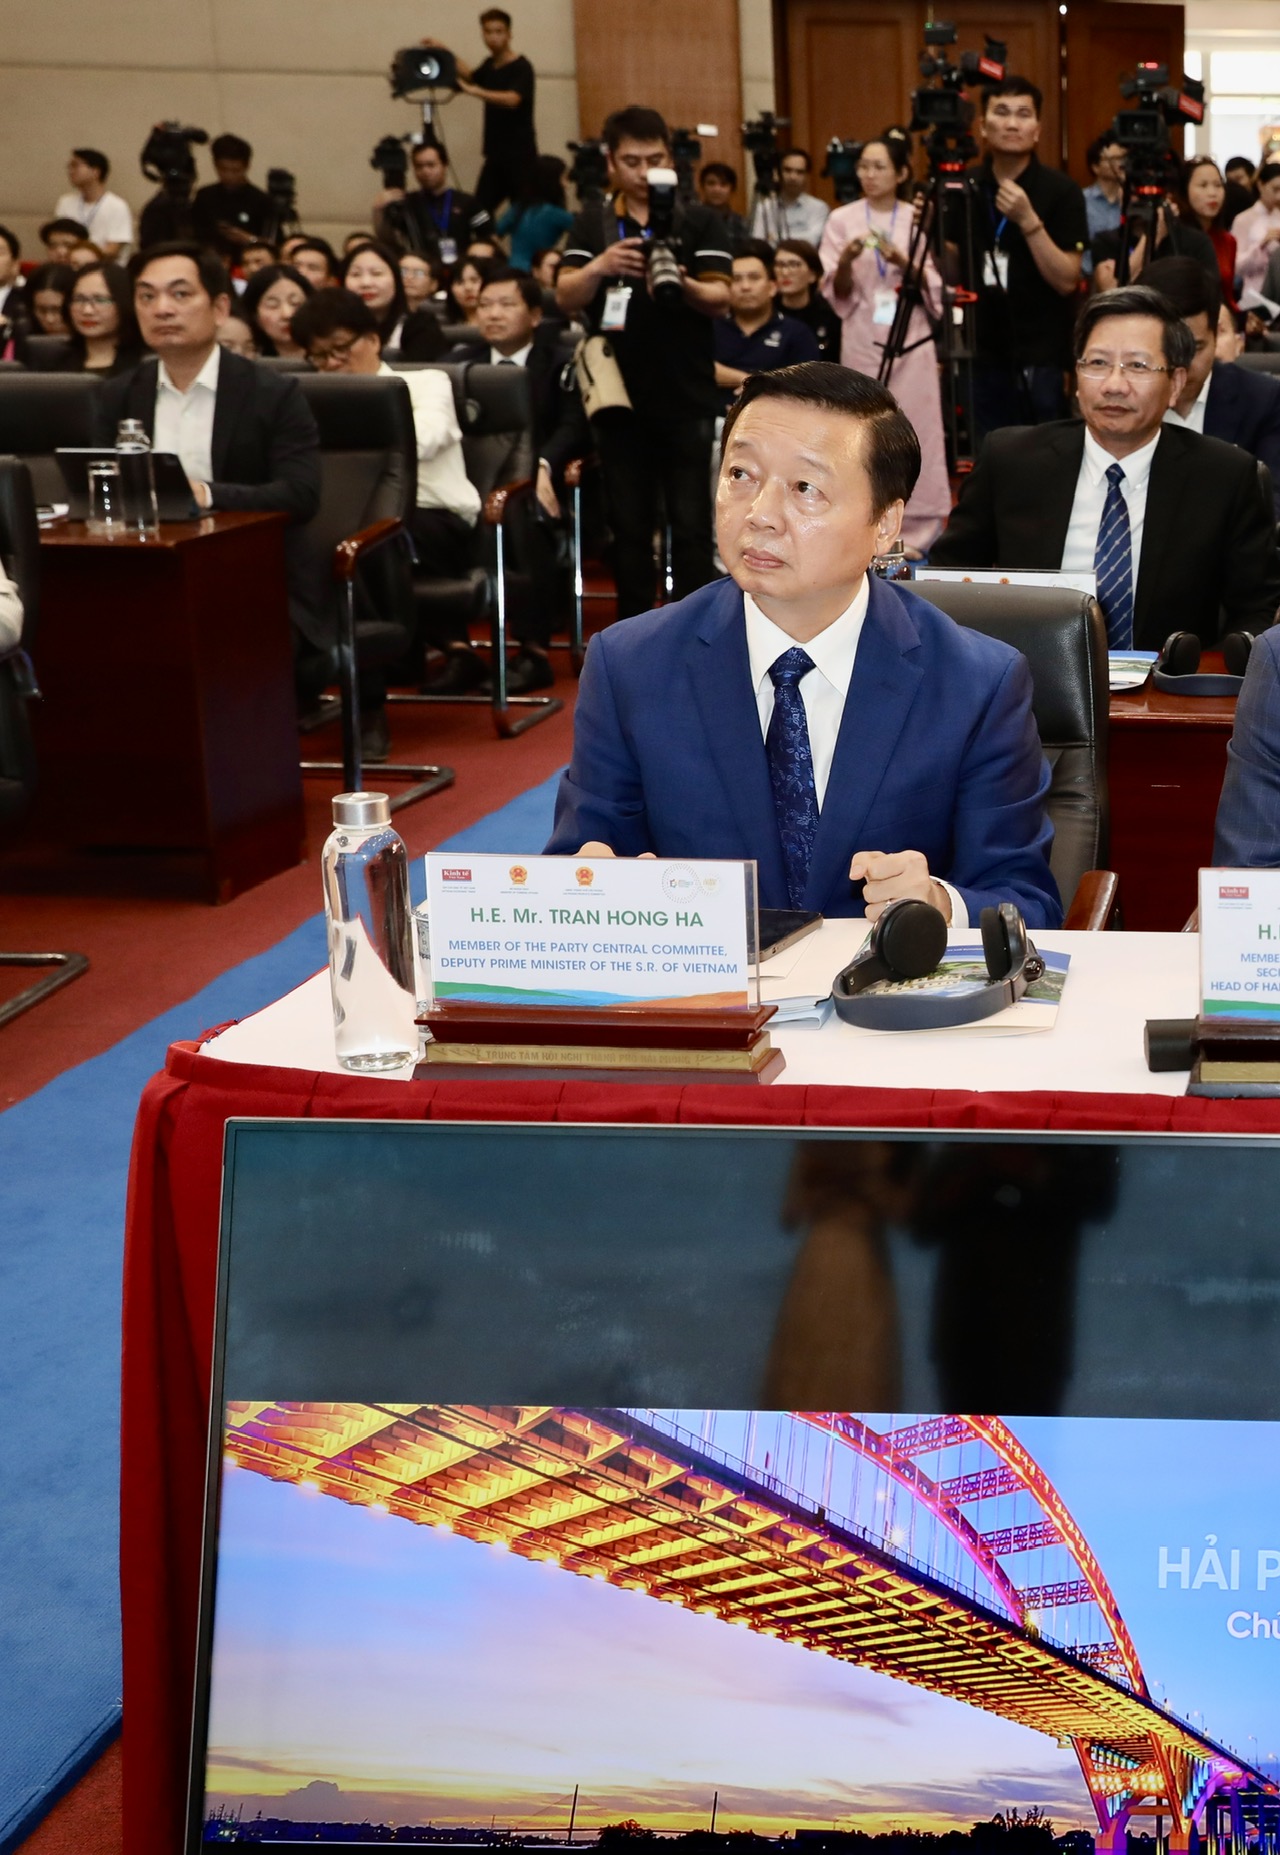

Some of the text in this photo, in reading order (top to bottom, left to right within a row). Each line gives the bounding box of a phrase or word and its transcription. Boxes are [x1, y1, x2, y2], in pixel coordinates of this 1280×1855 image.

[471, 908, 704, 927] H.E. Mr. TRAN HONG HA
[449, 940, 727, 957] MEMBER OF THE PARTY CENTRAL COMMITTEE,
[441, 958, 738, 974] DEPUTY PRIME MINISTER OF THE S.R. OF VIETNAM
[1211, 982, 1242, 991] HEAD
[1244, 982, 1259, 991] OF
[1158, 1534, 1240, 1590] HẢI
